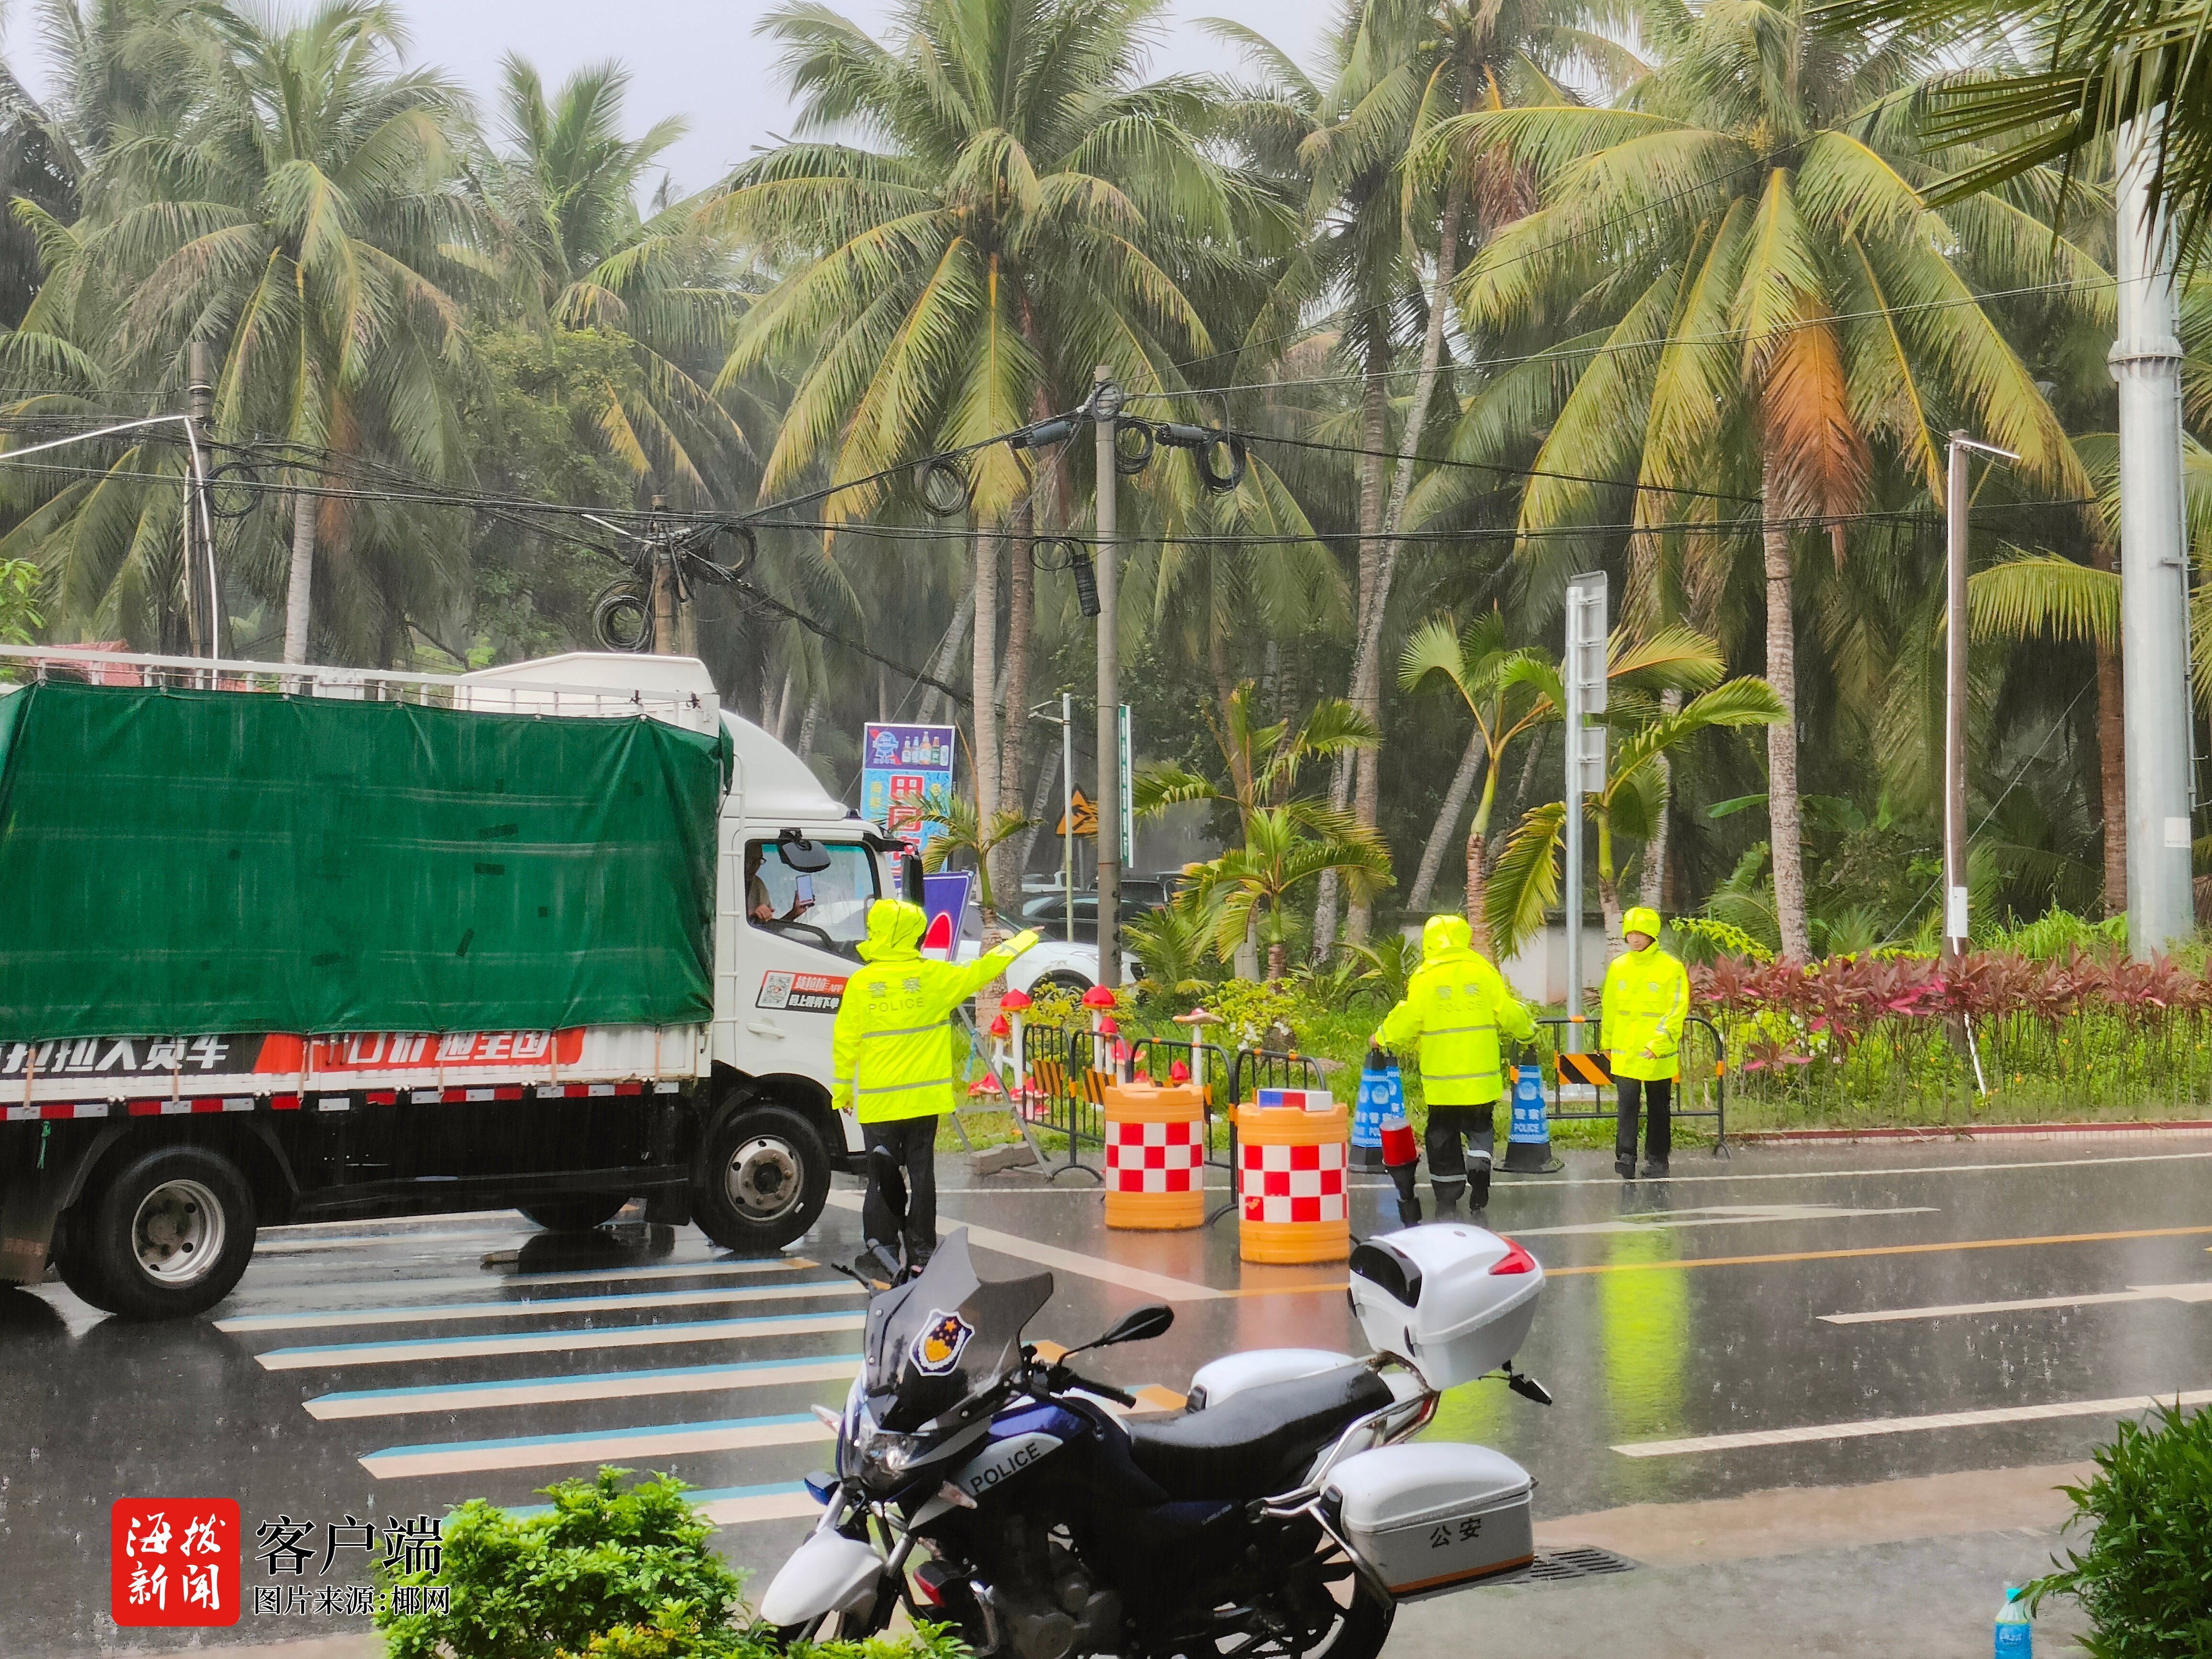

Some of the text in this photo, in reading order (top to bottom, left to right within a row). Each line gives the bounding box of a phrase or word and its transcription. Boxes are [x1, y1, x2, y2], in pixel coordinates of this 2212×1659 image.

[829, 984, 844, 993] APP
[868, 976, 921, 999] 警察
[868, 997, 924, 1013] POLICE
[970, 1441, 1041, 1493] POLICE
[1429, 1517, 1482, 1549] 公安
